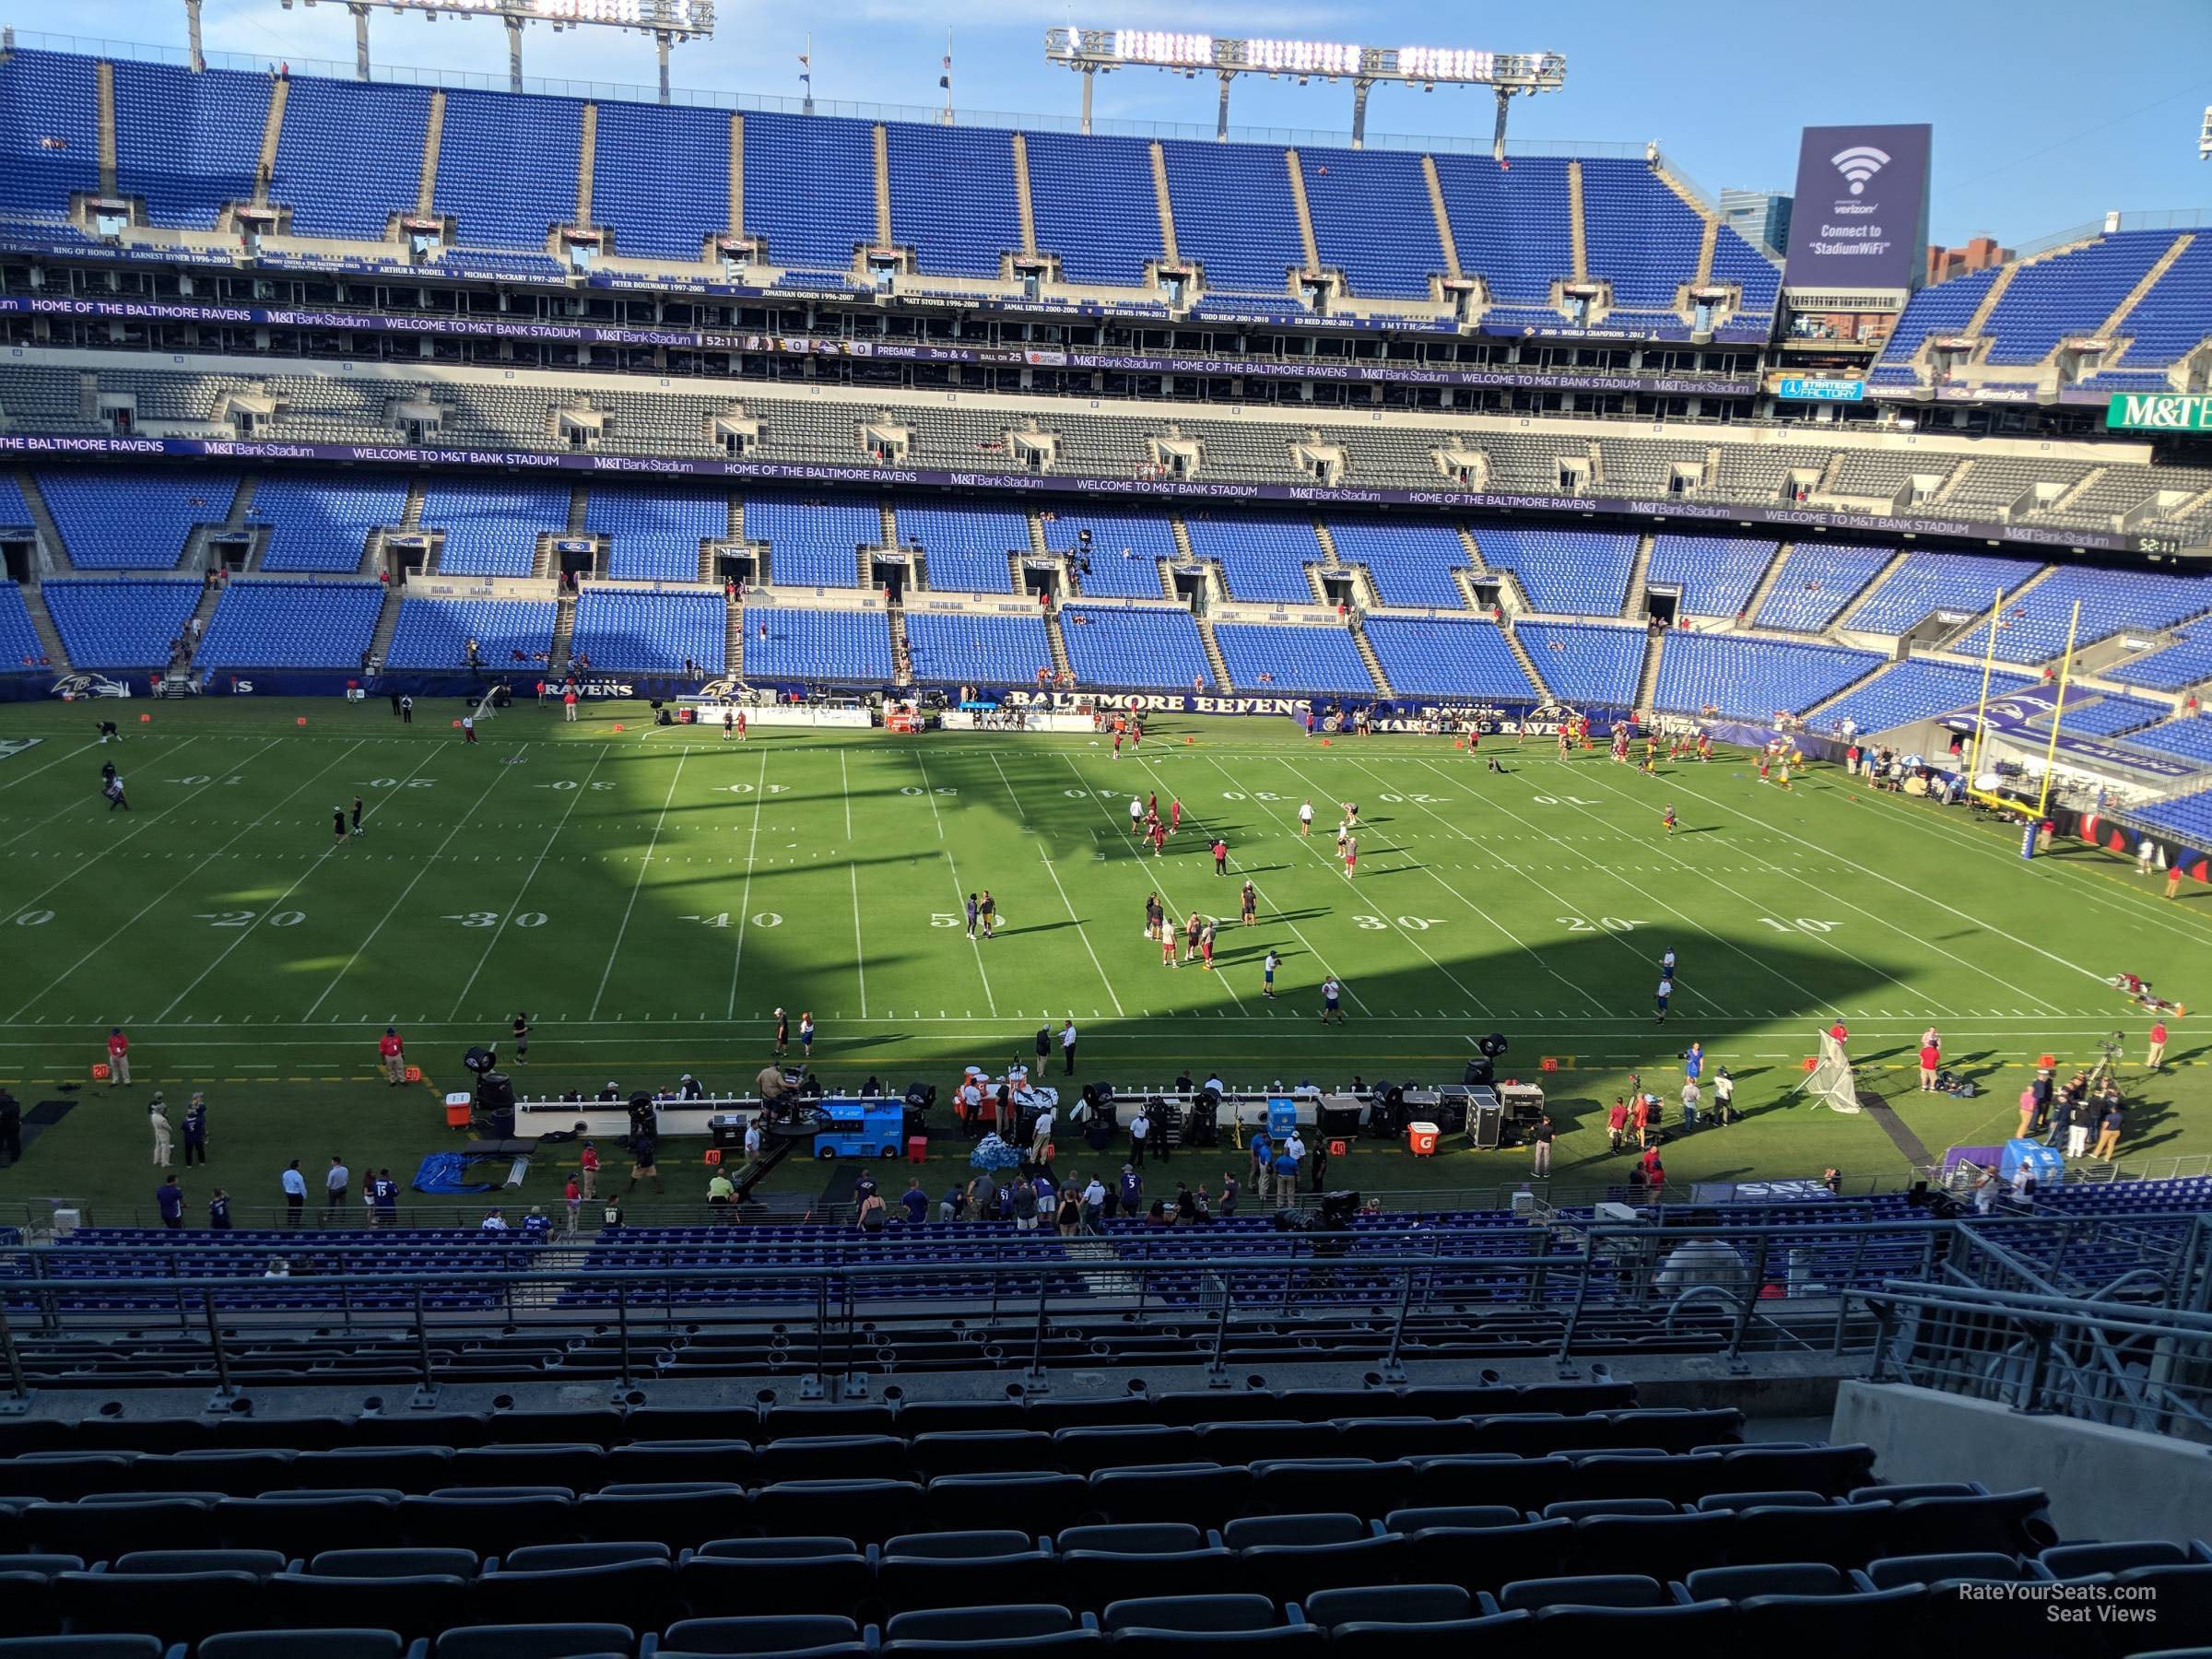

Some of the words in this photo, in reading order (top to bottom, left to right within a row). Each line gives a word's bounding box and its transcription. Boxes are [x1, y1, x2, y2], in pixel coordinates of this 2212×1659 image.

[1833, 205, 1875, 214] verizon
[1820, 224, 1868, 237] Connect
[1869, 225, 1882, 237] to
[53, 246, 73, 255] RING
[88, 248, 116, 257] HONOR
[131, 252, 164, 261] EARNEST
[166, 253, 190, 262] BYNER
[192, 254, 230, 265] 1996-2003
[380, 266, 407, 275] ARTHUR
[418, 268, 446, 276] MODELL
[464, 271, 494, 280] MICHAEL
[496, 272, 527, 281] McCRARY
[528, 274, 565, 284] 1997-2002
[612, 280, 631, 288] PETER
[633, 281, 669, 290] BOULWARE
[670, 284, 705, 292] 1997-2005
[762, 289, 795, 299] JONATHAN
[796, 291, 819, 300] OGDEN
[821, 292, 854, 301] 1996-2007
[31, 300, 71, 312] HOME
[75, 302, 94, 312] OF
[97, 303, 124, 315] THE
[126, 305, 198, 319] BALTIMORE
[202, 309, 251, 321] RAVENS
[947, 300, 980, 309] 1996-2008
[1004, 303, 1024, 312] JAMAL
[1045, 305, 1077, 313] 2000-2006
[267, 312, 296, 324] M&T
[297, 312, 323, 325] Bank
[324, 314, 370, 327] Stadium
[1236, 314, 1269, 324] 2001-2010
[1321, 319, 1354, 327] 2002-2012
[385, 317, 446, 331] WELCOME
[450, 322, 465, 332] TO
[468, 323, 493, 334] M&T
[497, 324, 528, 335] BANK
[531, 326, 581, 338] STADIUM
[1381, 322, 1416, 330] SMYTH
[1586, 330, 1625, 338] CHAMPIONS
[706, 336, 738, 347] 52:11
[793, 341, 802, 351] 0
[857, 345, 865, 354] 0
[877, 347, 916, 358] PREGAME
[930, 348, 947, 359] 3RD
[950, 349, 959, 359] &
[960, 350, 969, 359] 4
[981, 353, 995, 361] BALL
[1009, 352, 1021, 362] 25
[1074, 355, 1100, 366] M&T
[1100, 357, 1122, 367] Bank
[1123, 358, 1162, 370] Stadium
[1172, 360, 1203, 371] HOME
[1206, 361, 1220, 371] OF
[1223, 363, 1243, 373] THE
[1246, 364, 1305, 376] BALTIMORE
[1307, 367, 1347, 377] RAVENS
[1462, 372, 1514, 384] WELCOME
[1517, 375, 1532, 385] TO
[1535, 376, 1557, 386] M&T
[1560, 377, 1590, 387] BANK
[1592, 378, 1641, 389] STADIUM
[1801, 381, 1858, 390] STRATEGIC
[1800, 388, 1856, 398] FACTORY
[2122, 395, 2200, 428] M&T
[0, 437, 24, 449] THE
[29, 438, 108, 452] BALTIMORE
[111, 441, 164, 453] RAVENS
[205, 441, 235, 454] M&T
[237, 443, 265, 455] Bank
[266, 444, 314, 458] Stadium
[353, 447, 417, 461] WELCOME
[420, 450, 438, 462] TO
[441, 451, 466, 463] M&T
[470, 453, 503, 464] BANK
[507, 453, 559, 466] STADIUM
[594, 456, 622, 469] M&T
[623, 458, 649, 470] Bank
[650, 459, 693, 473] Stadium
[724, 464, 759, 475] HOME
[762, 465, 778, 476] OF
[782, 466, 804, 477] THE
[806, 467, 870, 479] BALTIMORE
[874, 470, 917, 482] RAVENS
[1077, 479, 1132, 491] WELCOME
[1135, 481, 1150, 491] TO
[1153, 482, 1176, 493] M&T
[1178, 483, 1208, 494] BANK
[1210, 485, 1258, 496] STADIUM
[1409, 492, 1441, 503] HOME
[1444, 493, 1460, 503] OF
[1464, 494, 1484, 505] THE
[1487, 495, 1548, 507] BALTIMORE
[1551, 498, 1596, 510] RAVENS
[1630, 500, 1659, 513] M&T
[1659, 503, 1685, 514] Bank
[1686, 504, 1730, 518] Stadium
[1765, 510, 1827, 524] WELCOME
[1830, 514, 1847, 524] TO
[1850, 515, 1876, 526] M&T
[1877, 517, 1912, 530] BANK
[1914, 520, 1970, 535] STADIUM
[2138, 537, 2176, 552] 52:11
[94, 1065, 107, 1077] 20
[1333, 1142, 1345, 1153] 40
[1419, 1135, 1432, 1149] G
[706, 1151, 720, 1163] 40
[1128, 1178, 1135, 1189] 5
[376, 1185, 387, 1197] 15
[605, 1210, 617, 1223] 10
